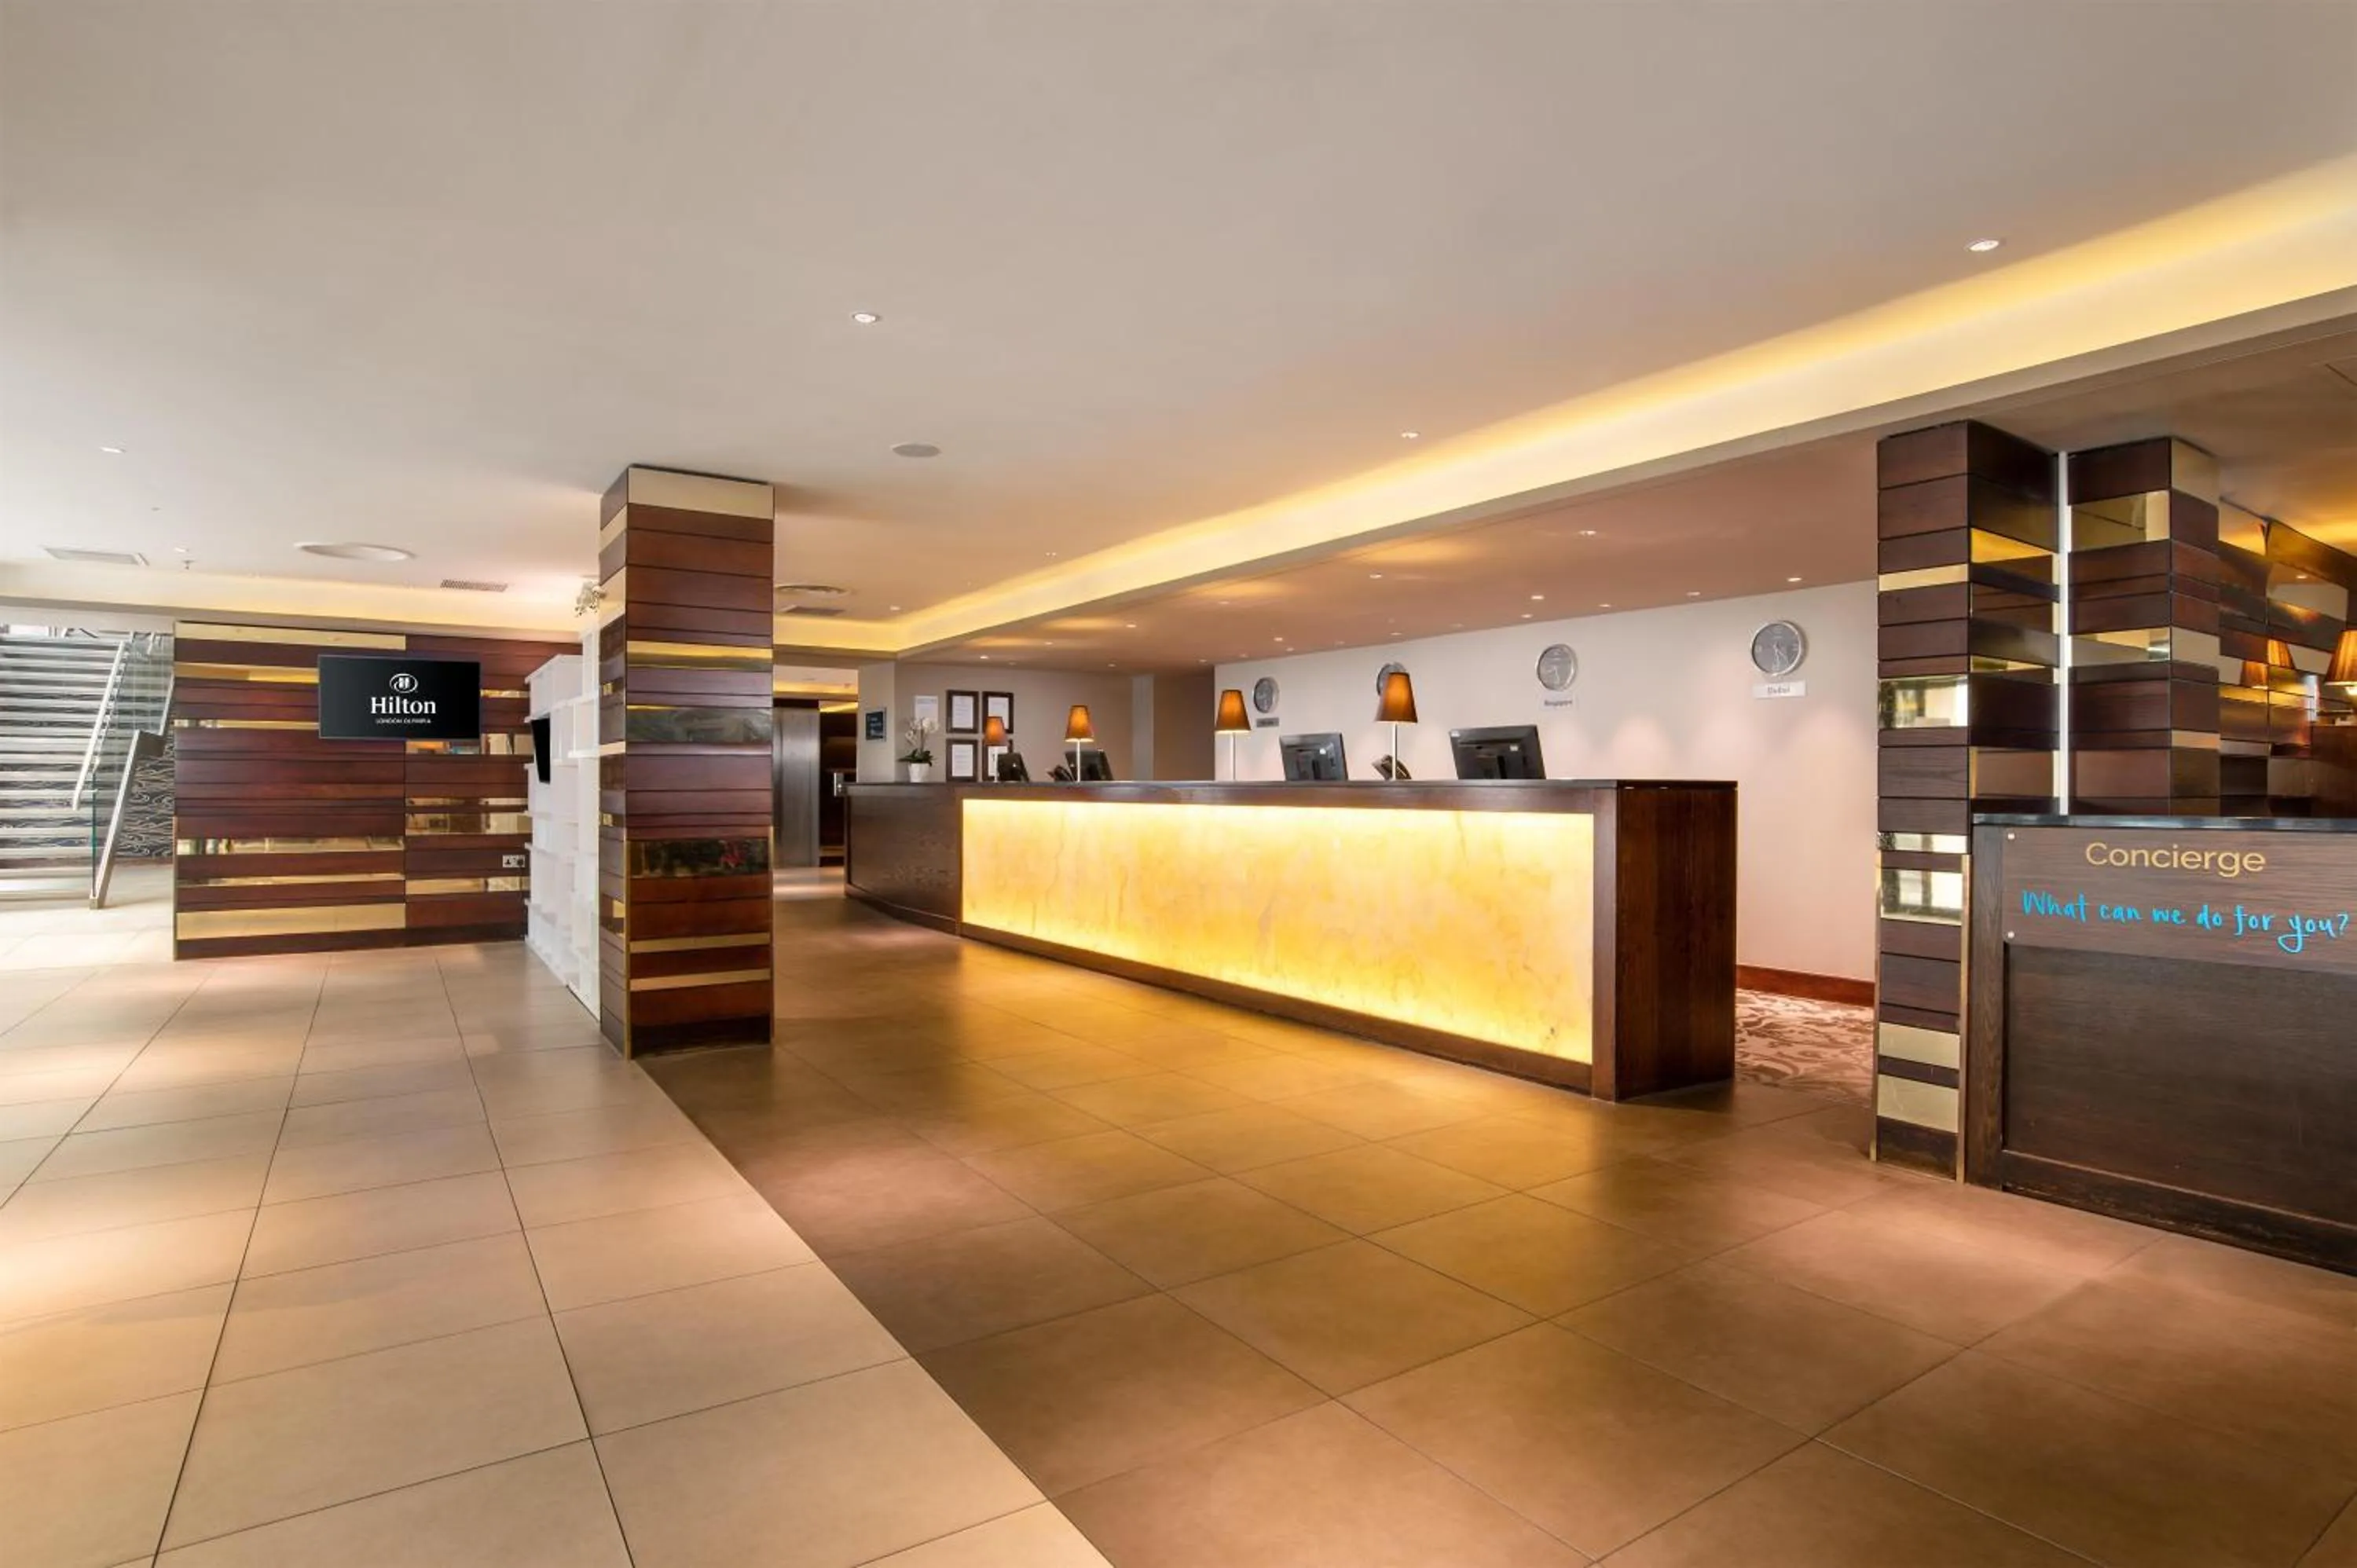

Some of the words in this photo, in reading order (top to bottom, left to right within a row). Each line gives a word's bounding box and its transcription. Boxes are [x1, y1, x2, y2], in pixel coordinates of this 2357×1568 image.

[370, 696, 436, 714] Hilton
[2085, 842, 2267, 878] Concierge
[2022, 890, 2088, 922] What
[2099, 905, 2143, 924] can
[2151, 907, 2187, 925] we
[2195, 904, 2223, 930] do
[2234, 905, 2275, 936] for
[2277, 913, 2349, 954] you?
